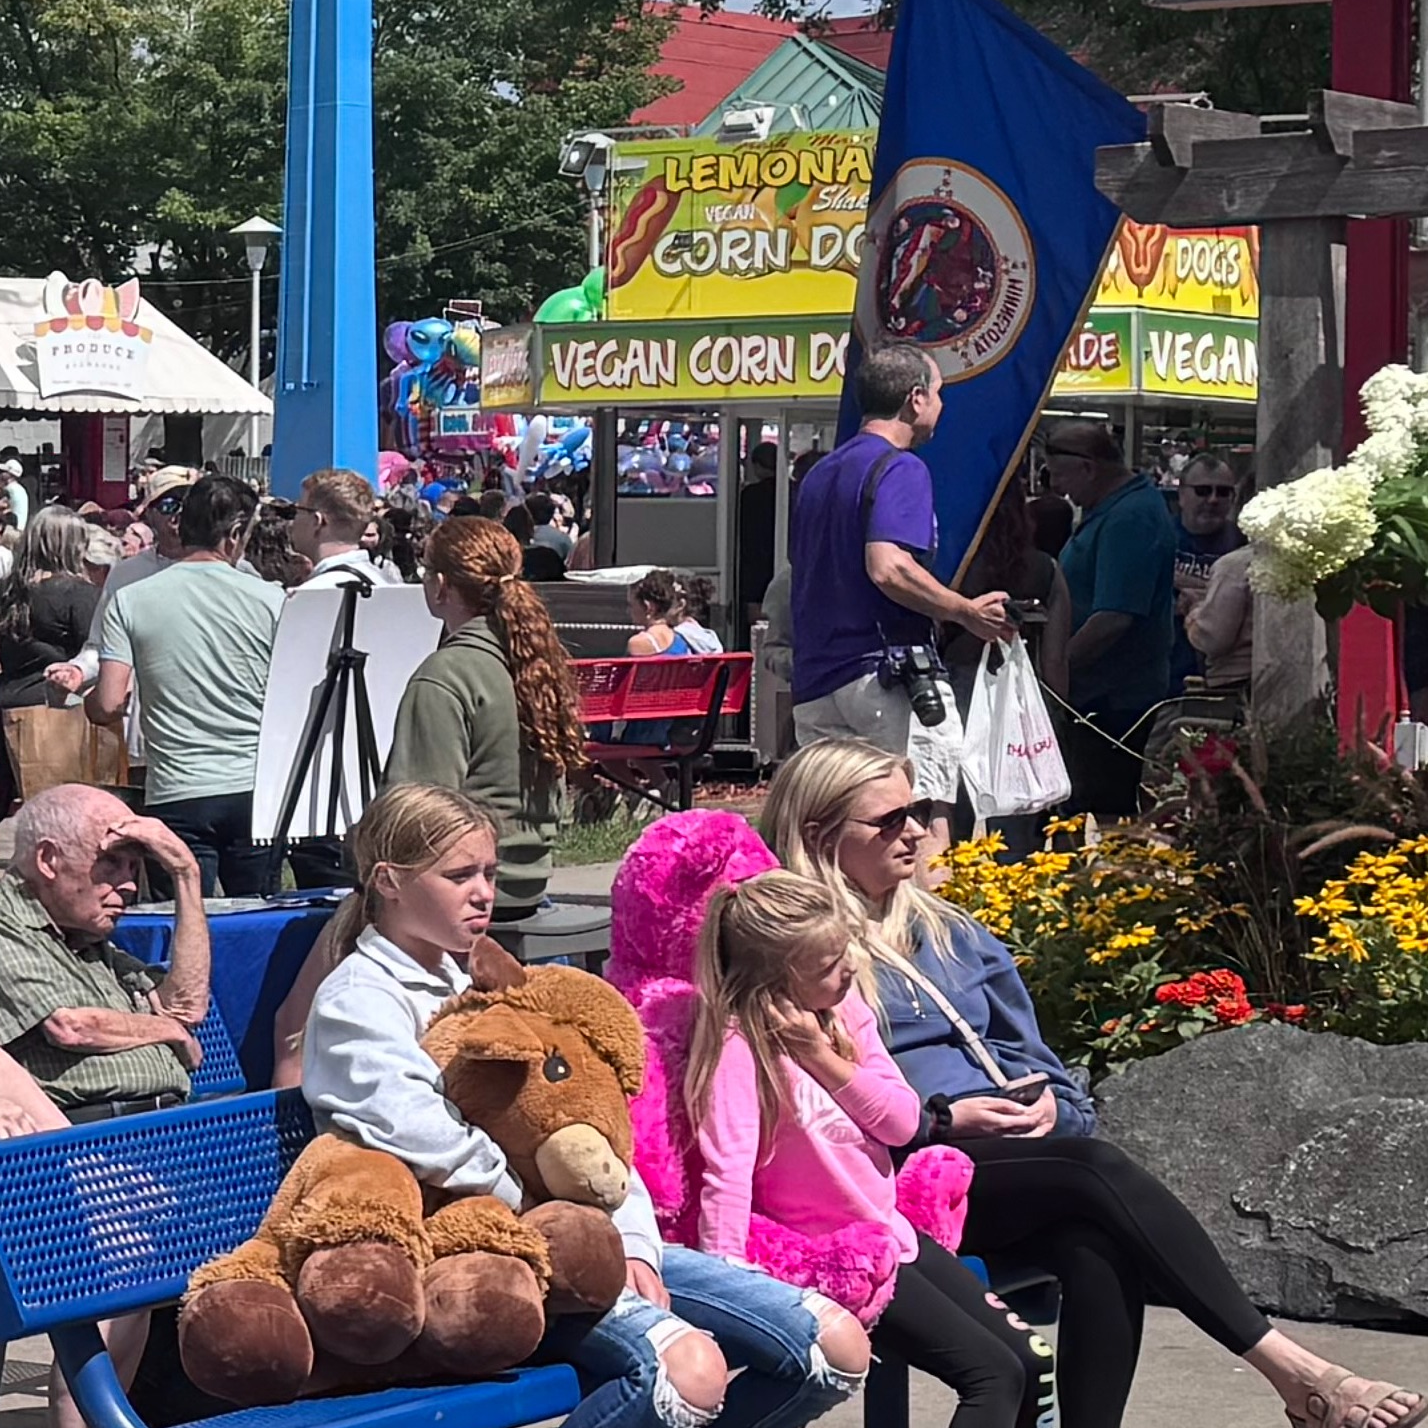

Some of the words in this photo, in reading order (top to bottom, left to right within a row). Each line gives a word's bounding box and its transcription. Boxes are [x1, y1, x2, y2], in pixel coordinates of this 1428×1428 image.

[664, 146, 872, 193] LEMONA
[705, 204, 757, 222] VEGAN
[652, 224, 792, 277] CORN
[810, 222, 866, 271] DO
[1175, 238, 1241, 288] DOGS
[551, 339, 677, 388] VEGAN
[689, 335, 796, 384] CORN
